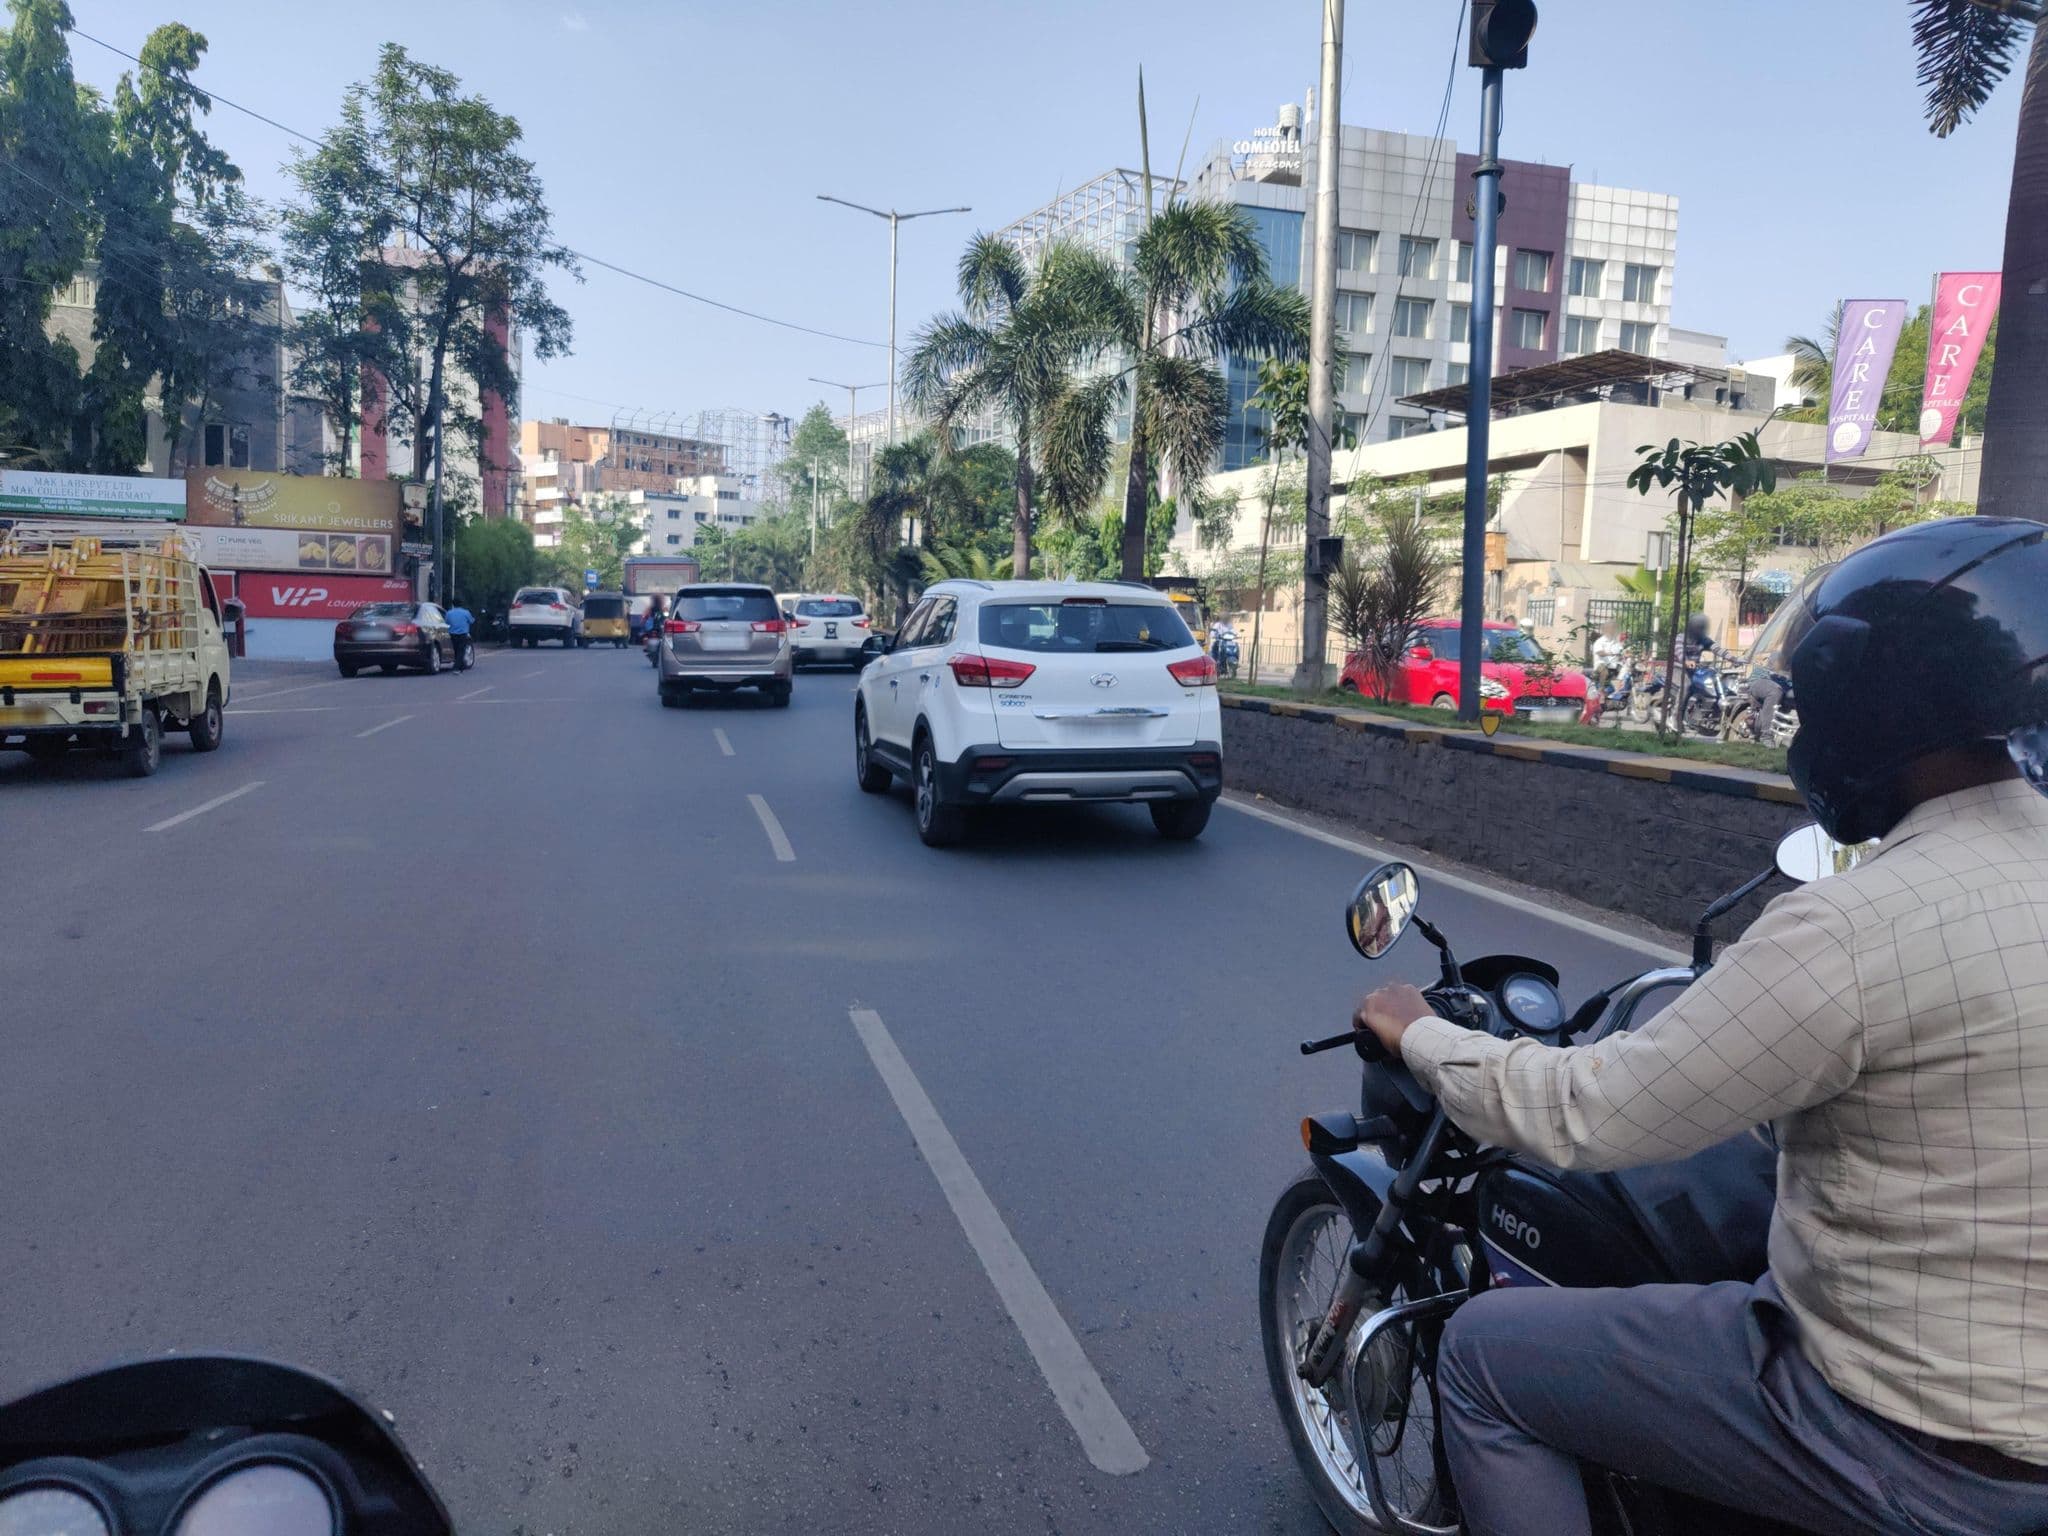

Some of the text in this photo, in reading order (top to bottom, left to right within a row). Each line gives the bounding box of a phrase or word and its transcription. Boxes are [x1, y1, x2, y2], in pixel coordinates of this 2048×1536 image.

[1254, 128, 1281, 137] HOTEL
[1233, 139, 1300, 154] COMFOTEL
[1932, 285, 1983, 396] CARE
[1844, 309, 1886, 411] CARE
[34, 476, 57, 487] MAK
[11, 484, 34, 495] MAK
[37, 486, 80, 497] COLLEGE
[83, 488, 96, 498] OF
[273, 513, 394, 529] SRIKANT JEWELLERS
[1492, 1203, 1540, 1249] Hero
